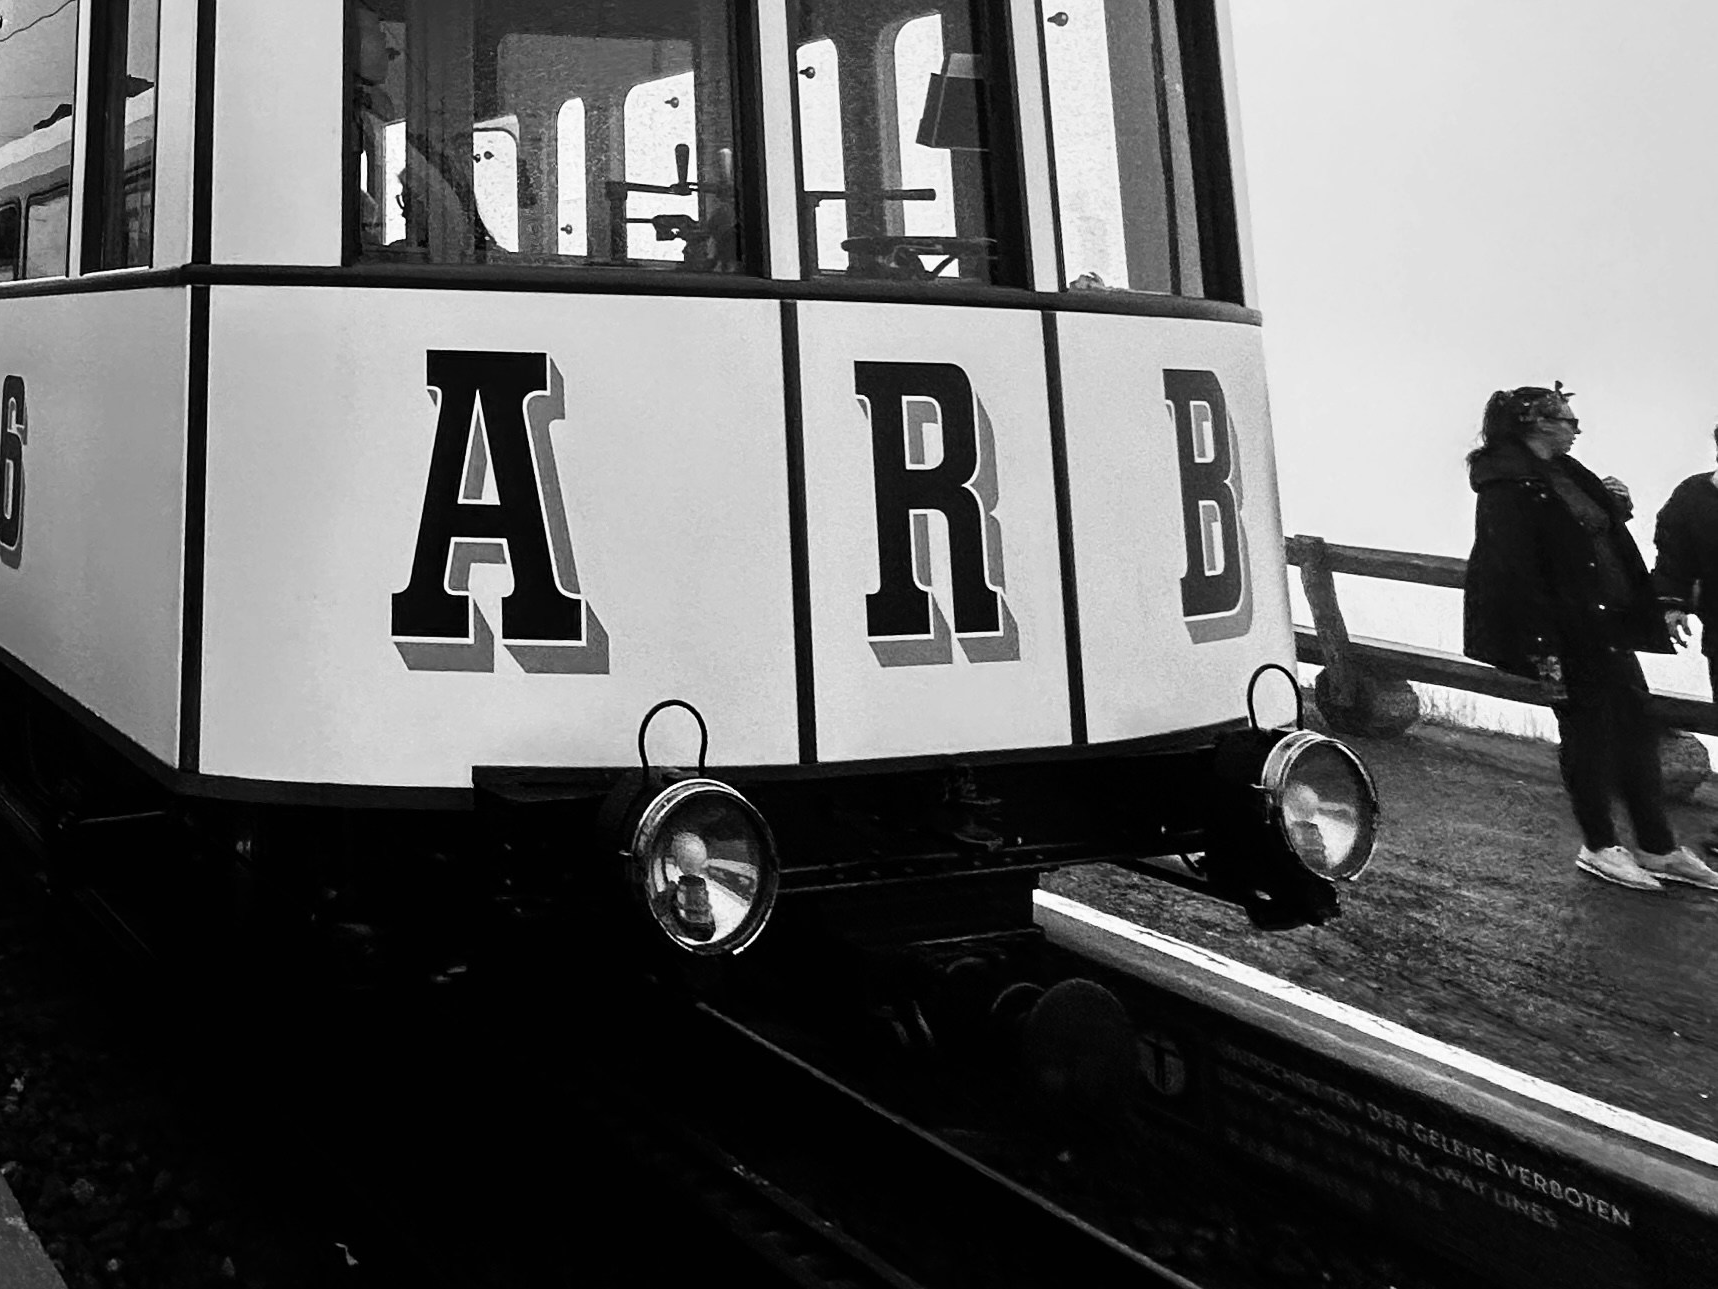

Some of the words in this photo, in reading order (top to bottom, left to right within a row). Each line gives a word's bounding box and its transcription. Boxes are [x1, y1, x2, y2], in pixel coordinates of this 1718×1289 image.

[1366, 1102, 1409, 1135] DER
[1413, 1122, 1500, 1175] GELEISE
[1500, 1157, 1632, 1228] VERBOTEN
